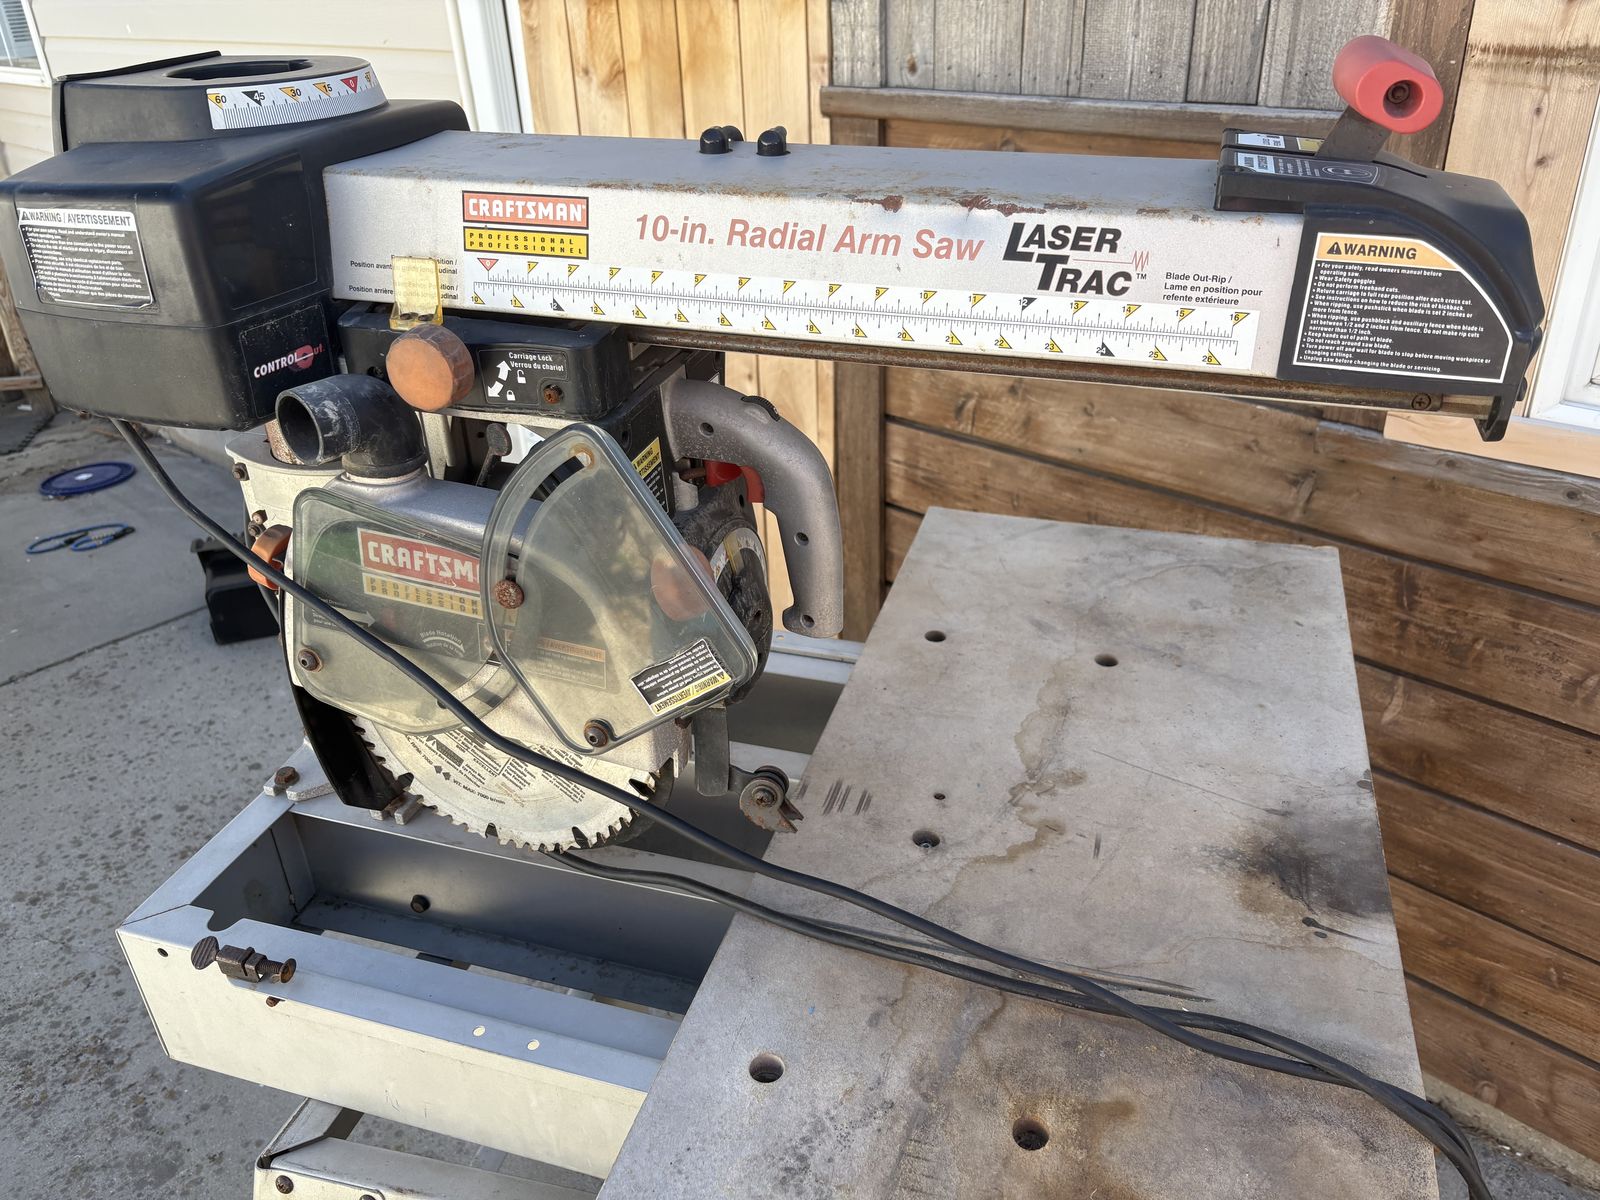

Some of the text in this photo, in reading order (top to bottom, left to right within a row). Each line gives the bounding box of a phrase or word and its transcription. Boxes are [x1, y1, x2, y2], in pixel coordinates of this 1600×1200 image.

[215, 95, 227, 104] 60
[253, 91, 266, 101] 45
[291, 88, 302, 97] 30
[323, 84, 333, 92] 15
[29, 211, 62, 223] WARNING
[67, 213, 131, 227] AVERTISSEMENT
[468, 198, 584, 222] CRAFTSMAN
[469, 232, 574, 245] PROFESSIONAL
[635, 214, 985, 261] 10-in. Radial Arm Saw
[1002, 222, 1122, 263] LASER
[469, 241, 584, 255] PROFESSIONNEL
[1343, 242, 1418, 260] WARNING
[1036, 253, 1133, 297] TRAC
[1165, 272, 1233, 285] Blade Out-Rip /
[349, 285, 394, 295] Position arrière
[527, 262, 532, 270] 1
[567, 265, 573, 273] 2
[609, 268, 615, 276] 3
[919, 292, 929, 300] 10
[968, 295, 977, 303] 11
[1018, 298, 1028, 306] 12
[1069, 302, 1079, 310] 13
[1121, 305, 1131, 313] 14
[1175, 309, 1185, 317] 15
[1229, 313, 1240, 321] 16
[1162, 293, 1239, 305] refente extérieure
[1163, 283, 1263, 297] Lame en position pour
[1390, 293, 1414, 301] position
[550, 302, 558, 310] 12
[631, 309, 640, 317] 14
[717, 316, 725, 324] 16
[760, 320, 769, 328] 17
[805, 324, 814, 332] 18
[851, 327, 860, 335] 19
[945, 335, 955, 343] 21
[994, 339, 1004, 347] 22
[1044, 342, 1055, 350] 23
[1096, 346, 1107, 355] 24
[1148, 350, 1159, 359] 25
[1201, 354, 1213, 363] 26
[254, 352, 306, 378] CONTROL
[508, 352, 553, 362] Carriage Lock
[509, 360, 532, 369] Verrou
[541, 363, 565, 372] chariot
[367, 541, 480, 583] CRAFTSM
[695, 675, 720, 693] WARNING
[654, 687, 691, 713] AVERTISSEMENT
